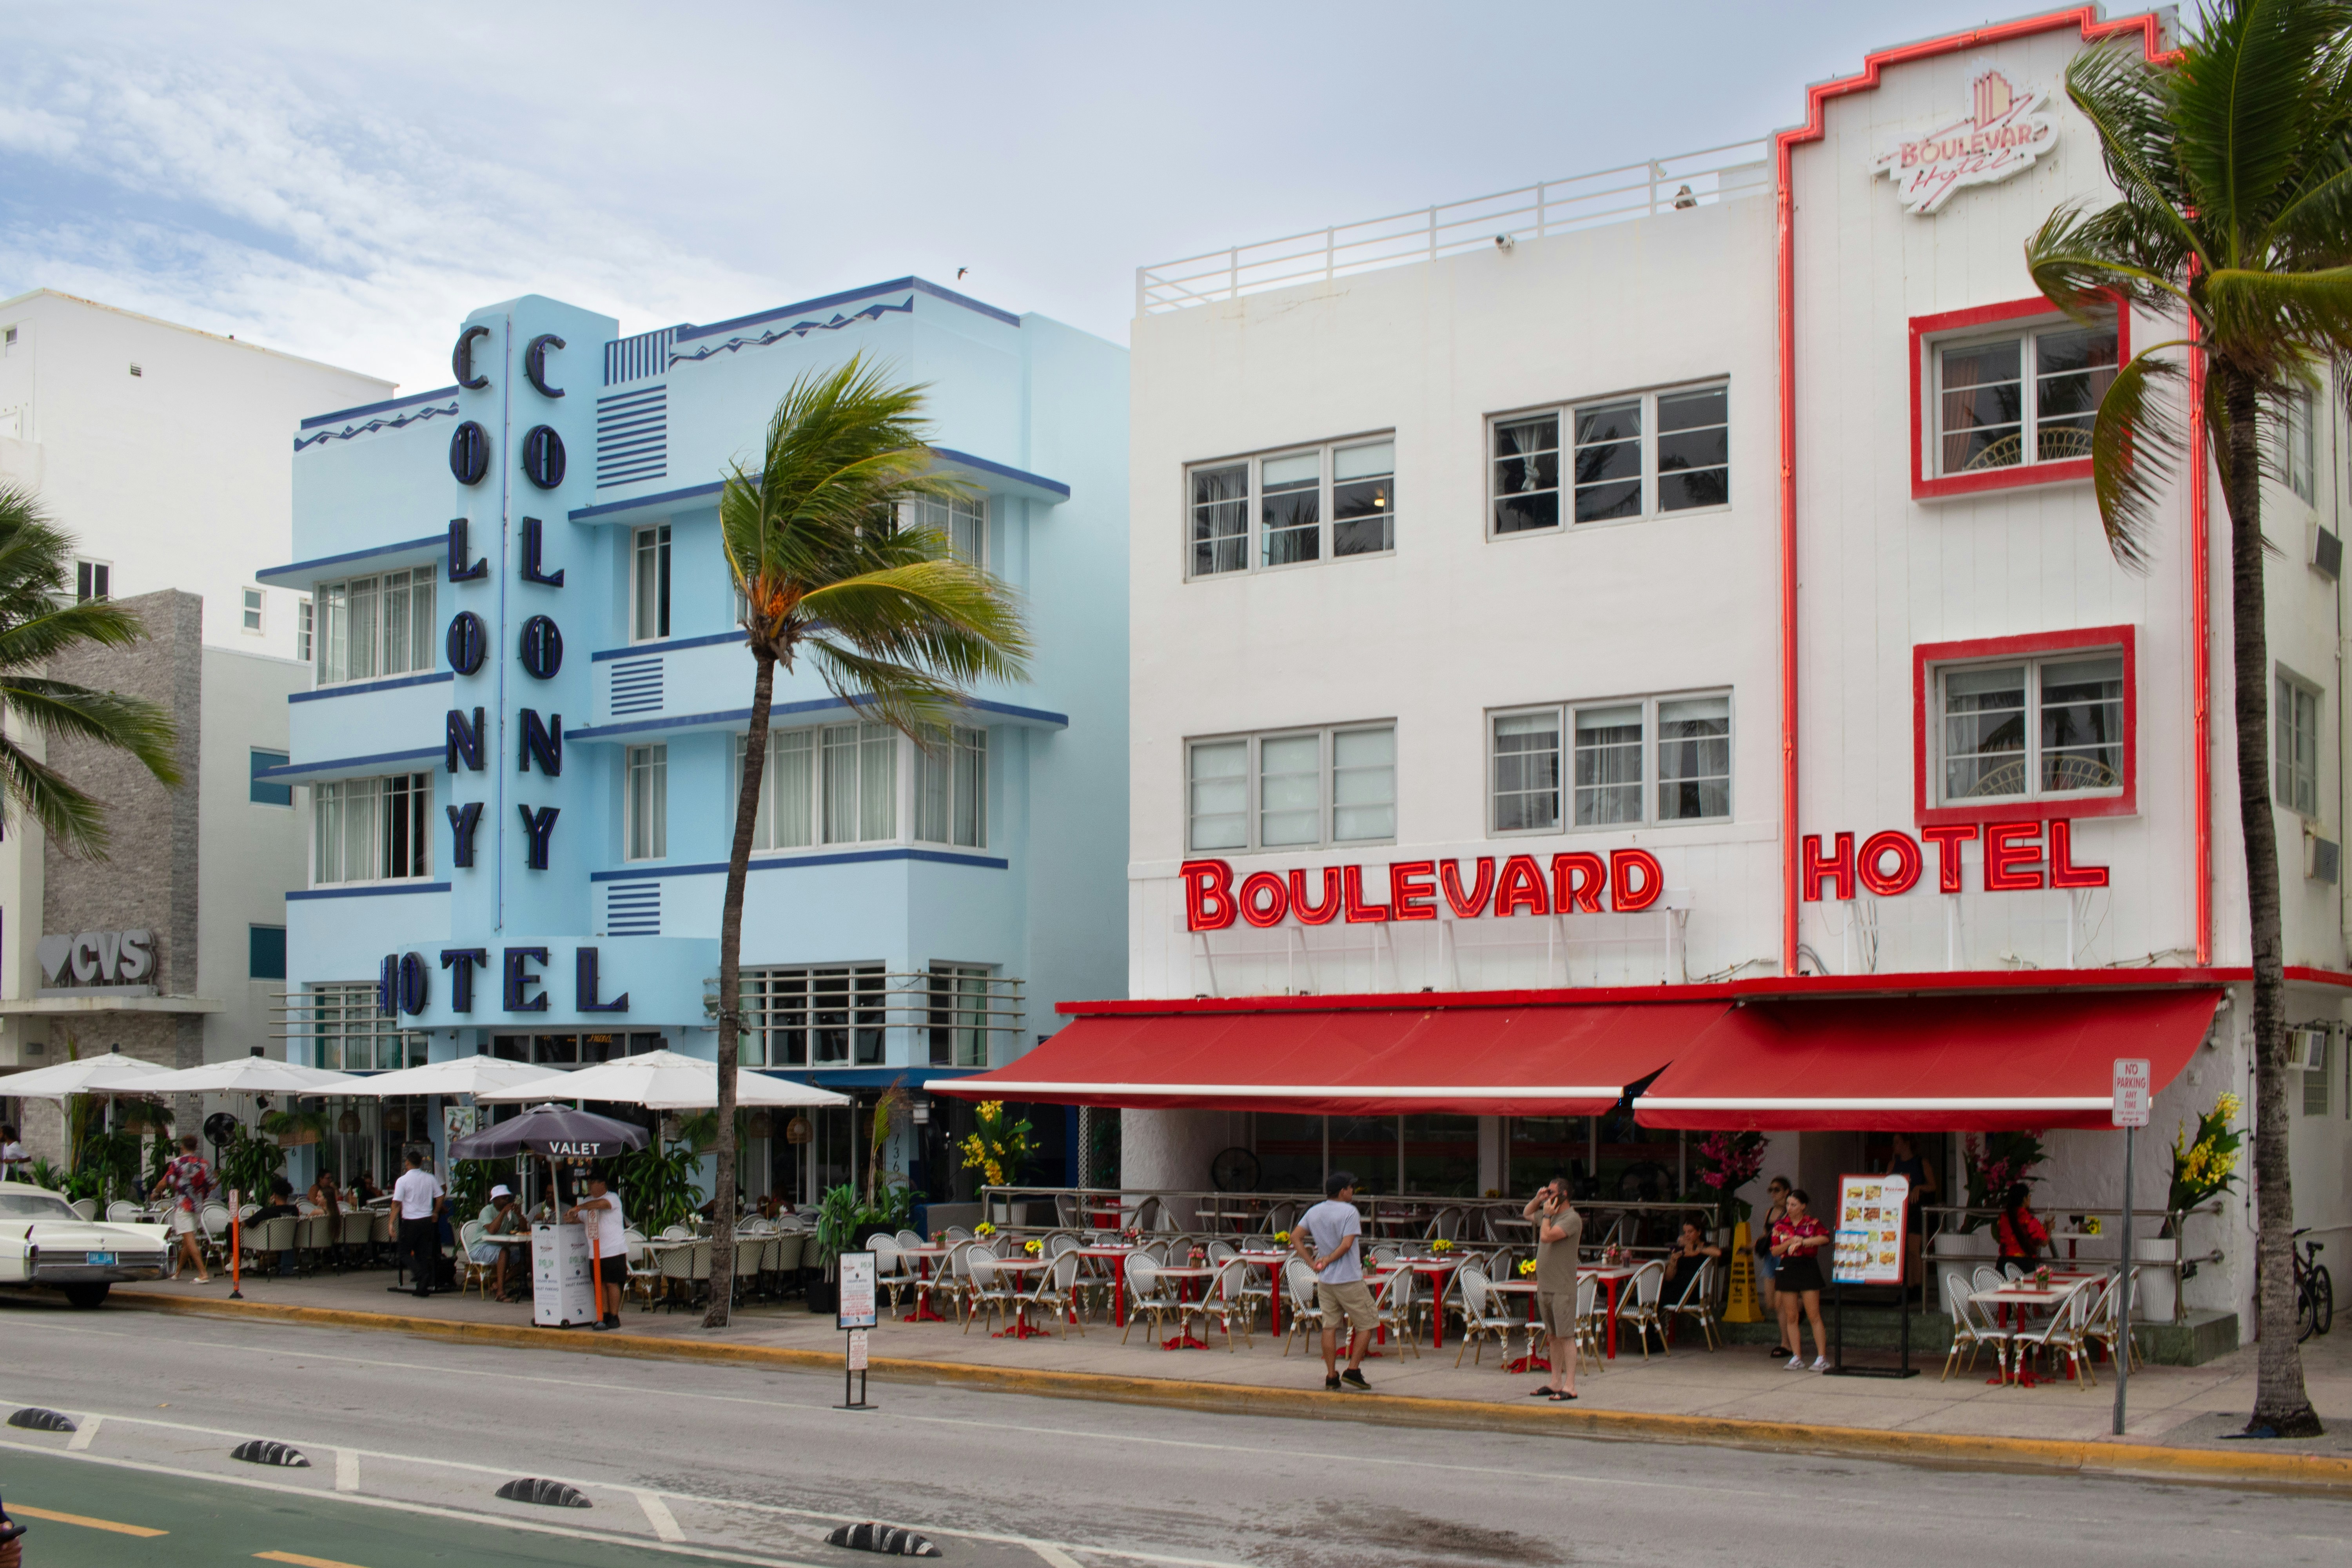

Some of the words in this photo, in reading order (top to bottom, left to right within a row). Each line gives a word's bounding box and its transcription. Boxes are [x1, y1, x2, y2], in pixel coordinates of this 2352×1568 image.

[1910, 149, 2025, 212] Hotel
[446, 325, 490, 868] COLONY
[518, 334, 566, 870] COLONY
[1803, 819, 2109, 902] HOTEL
[1179, 848, 1664, 932] BOULEVARD
[71, 928, 156, 982] CVS
[2117, 1077, 2146, 1089] PARKING
[2125, 1064, 2138, 1075] NO
[2125, 1091, 2137, 1099] ANY
[549, 1141, 600, 1155] VALET
